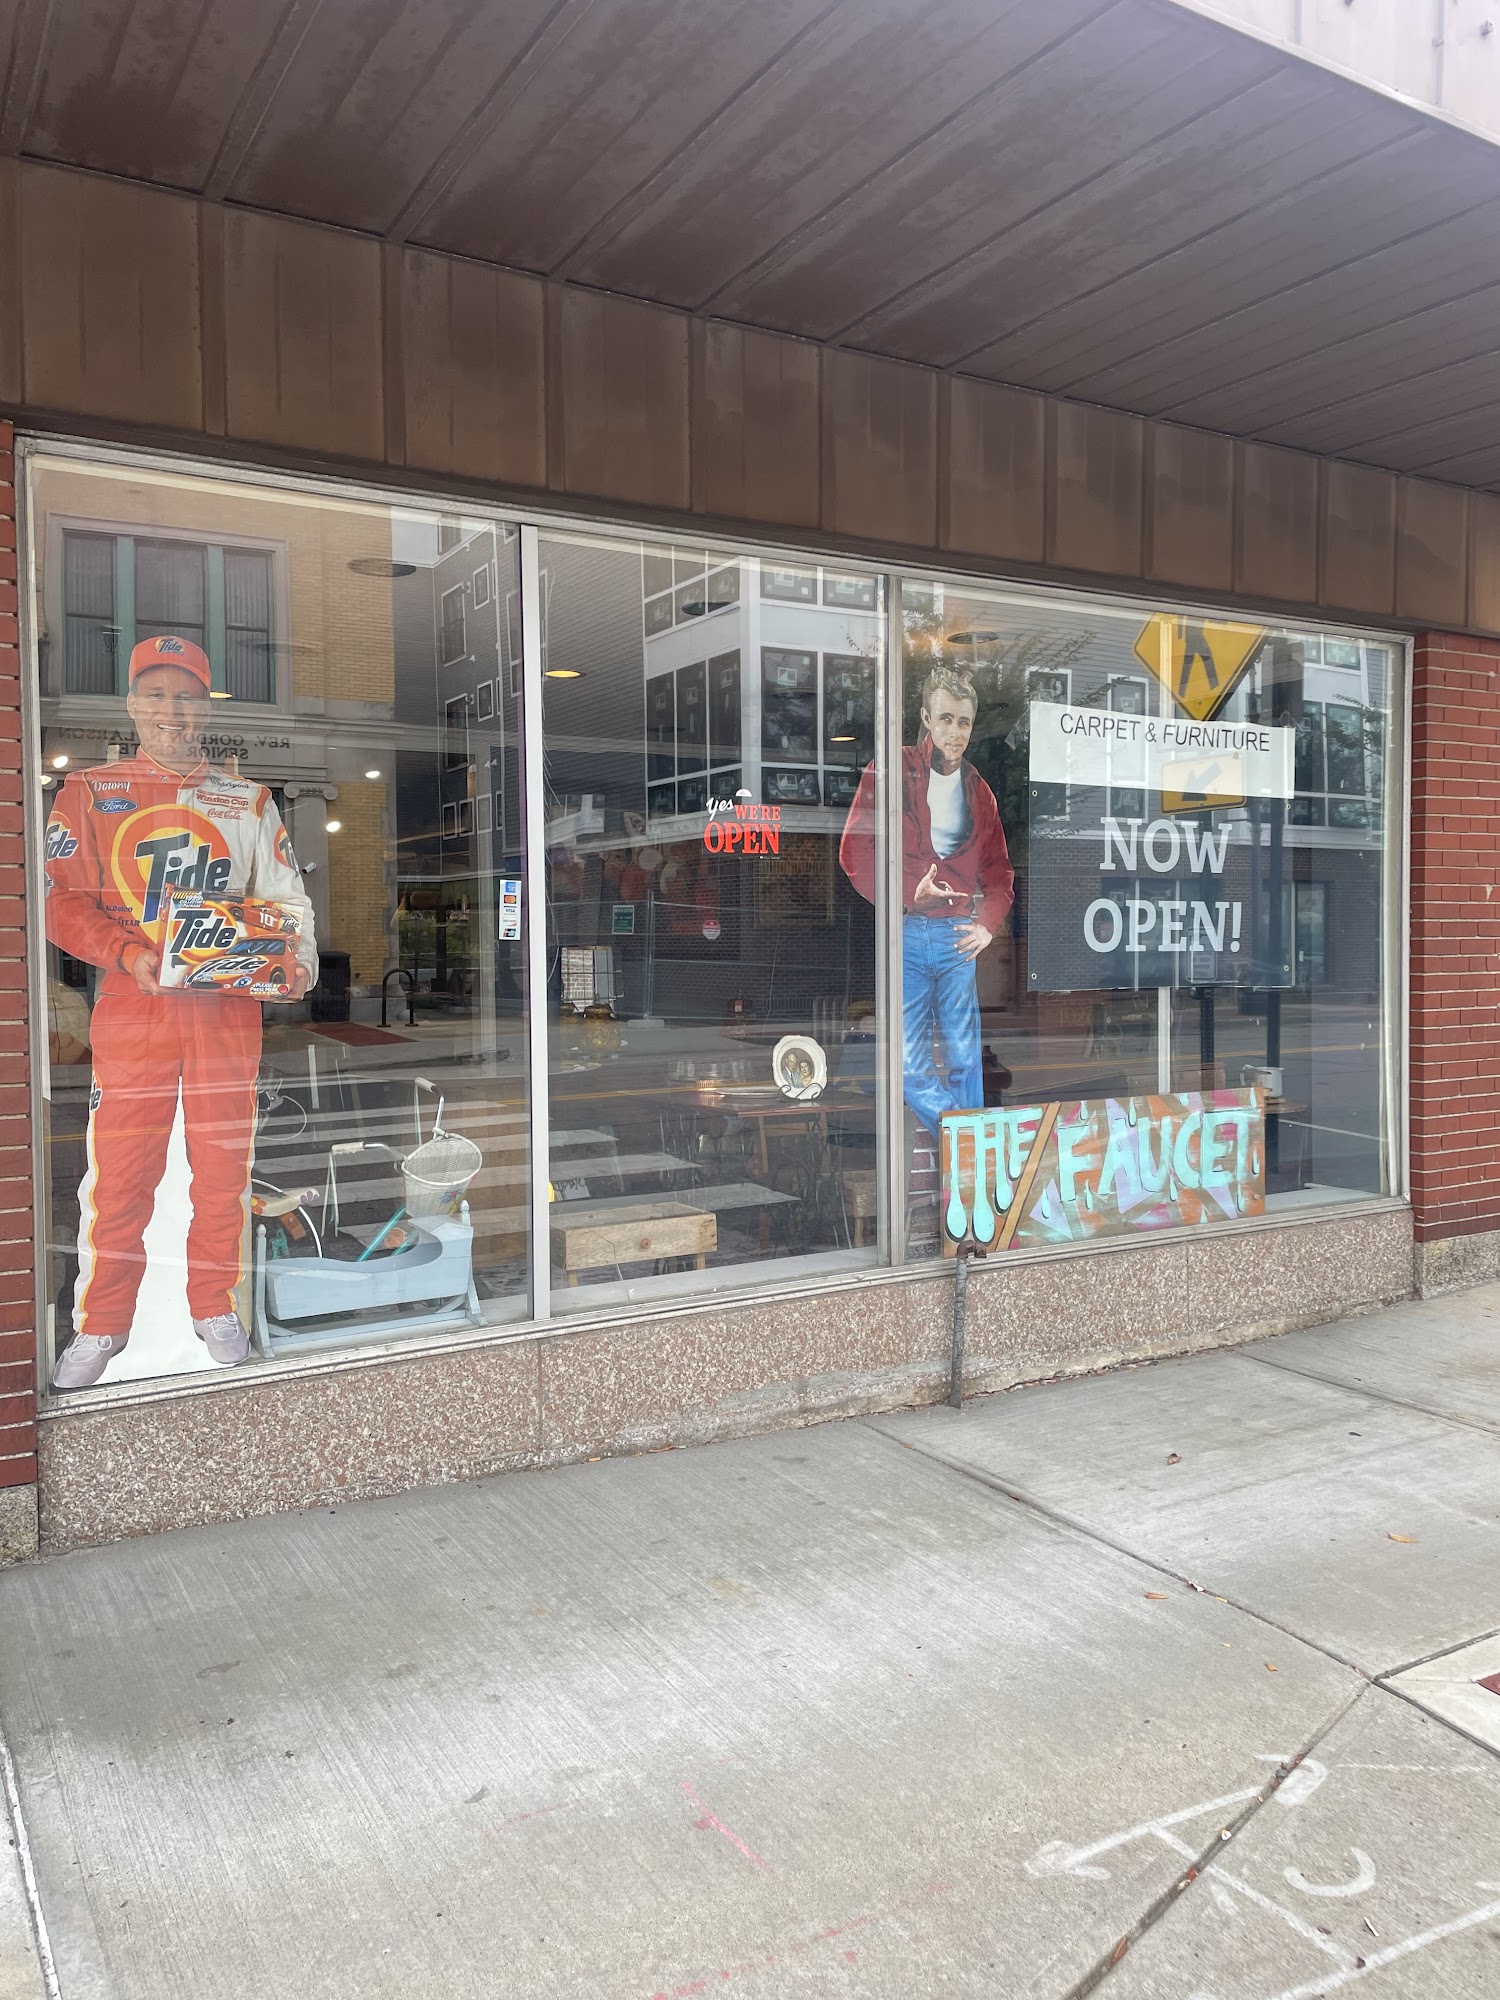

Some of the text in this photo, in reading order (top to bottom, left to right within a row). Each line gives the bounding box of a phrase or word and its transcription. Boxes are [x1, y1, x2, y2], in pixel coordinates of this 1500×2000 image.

[158, 638, 183, 653] Tide
[1060, 712, 1270, 752] CARPET & FURNITURE
[91, 780, 130, 793] Downy
[196, 793, 249, 807] Winston Cup
[102, 801, 128, 811] Ford
[734, 804, 781, 821] WE'RE
[704, 821, 781, 855] OPEN
[1100, 817, 1233, 874] NOW
[134, 833, 231, 923] Tide
[169, 909, 237, 954] Tide
[259, 911, 275, 927] 10
[1083, 898, 1243, 953] OPEN!
[941, 1107, 1261, 1243] THE FAUCET
